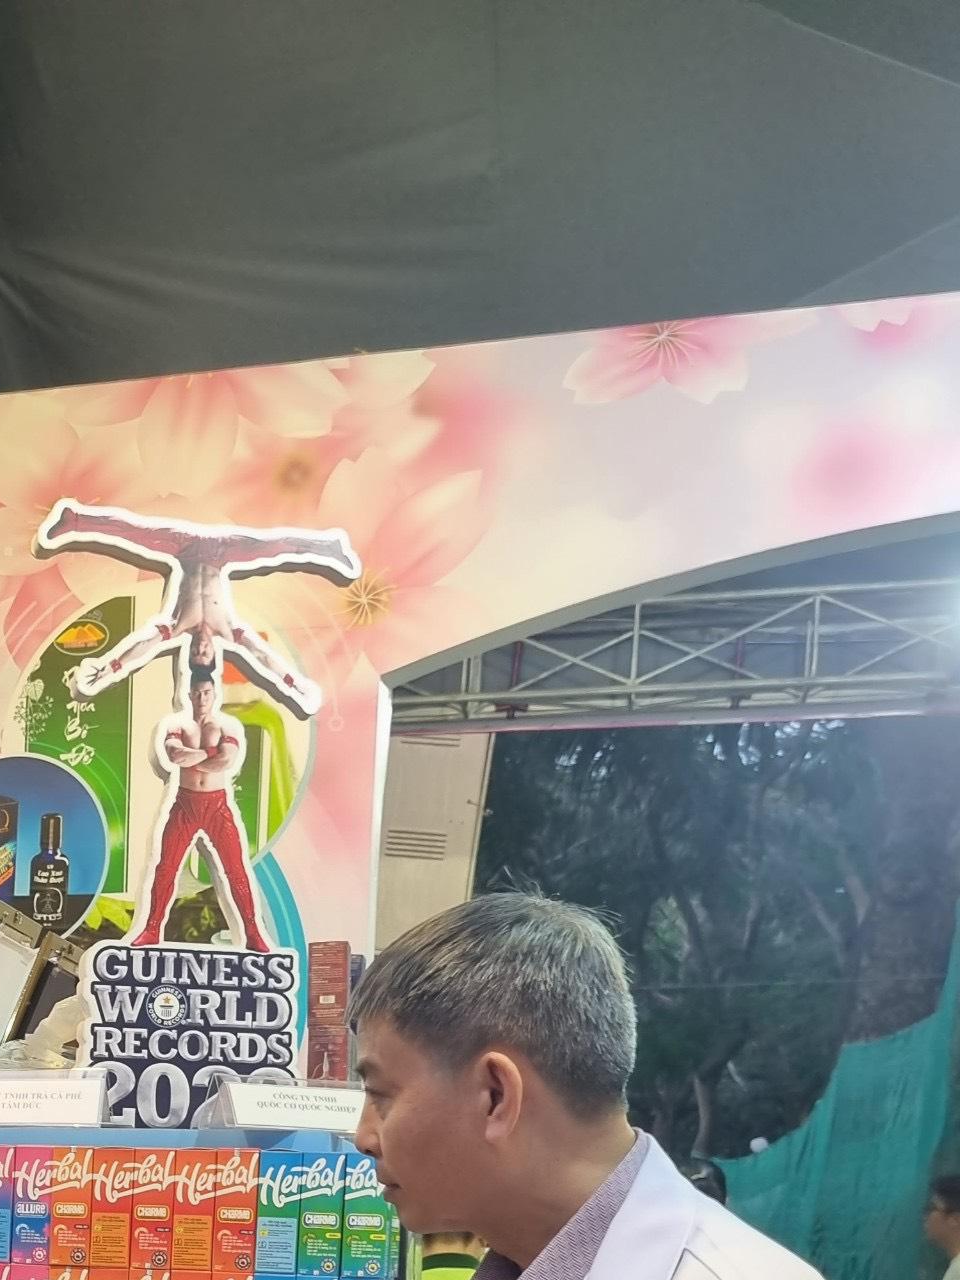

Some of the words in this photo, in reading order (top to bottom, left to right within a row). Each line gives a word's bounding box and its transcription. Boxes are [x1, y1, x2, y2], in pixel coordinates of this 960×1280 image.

[96, 949, 292, 990] GUINESS
[93, 1026, 290, 1064] RECORDS
[12, 1149, 94, 1200] Herbal
[92, 1151, 175, 1203] Herbal
[173, 1152, 259, 1205] Herbal
[258, 1154, 346, 1207] Herbal
